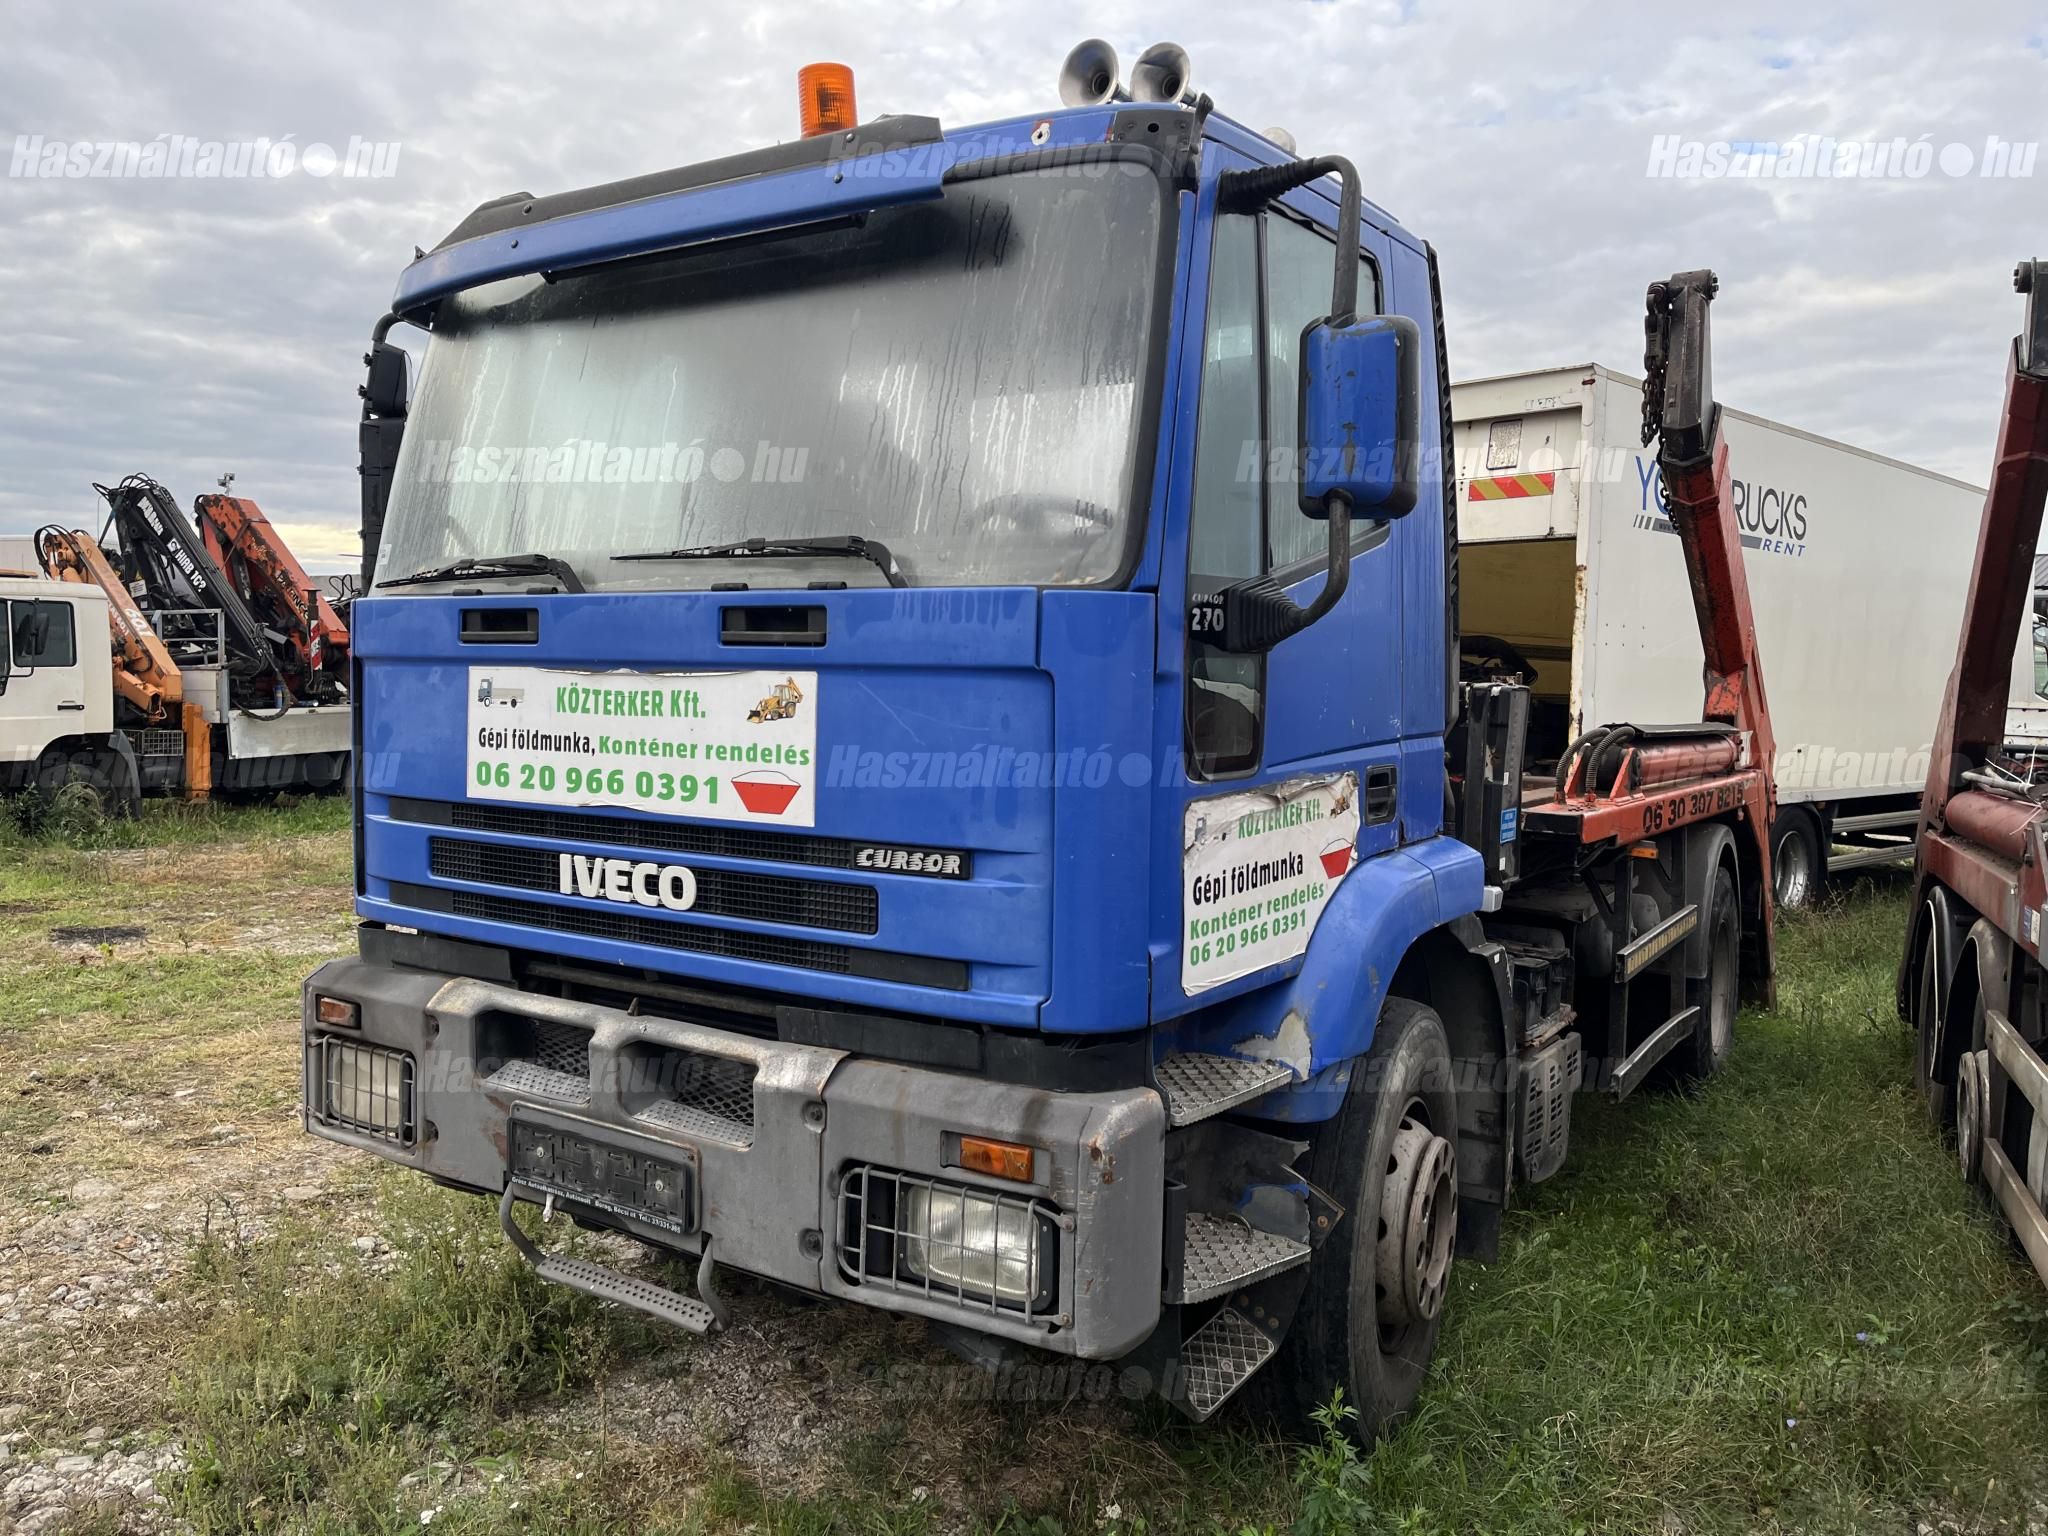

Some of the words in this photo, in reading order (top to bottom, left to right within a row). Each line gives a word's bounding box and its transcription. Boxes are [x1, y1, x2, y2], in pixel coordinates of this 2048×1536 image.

[1732, 479, 1807, 541] RUCKS
[174, 549, 195, 575] HIAB
[1762, 538, 1806, 557] RENT
[1191, 607, 1225, 631] 270
[556, 682, 664, 718] KÖZTERKER
[670, 689, 706, 718] Kft.
[478, 728, 508, 751] Gépi
[511, 729, 596, 757] földmunka,
[599, 736, 698, 759] Konténer
[705, 743, 810, 766] rendelés
[476, 761, 510, 788] 06
[519, 764, 556, 792] 20
[565, 767, 624, 795] 966
[635, 771, 719, 804] 0391
[1643, 803, 1664, 833] 06
[1668, 798, 1686, 825] 30
[1690, 790, 1714, 816] 307
[559, 853, 697, 911] IVECO
[856, 848, 962, 876] CURSOR
[1192, 866, 1227, 906] Gépi
[1231, 851, 1304, 896] földmunka
[1190, 903, 1263, 941] Konténer
[1267, 882, 1325, 915] rendelés
[1190, 943, 1211, 966] 06
[1215, 933, 1236, 958] 20
[1240, 923, 1268, 947] 966
[1272, 909, 1306, 937] 0391
